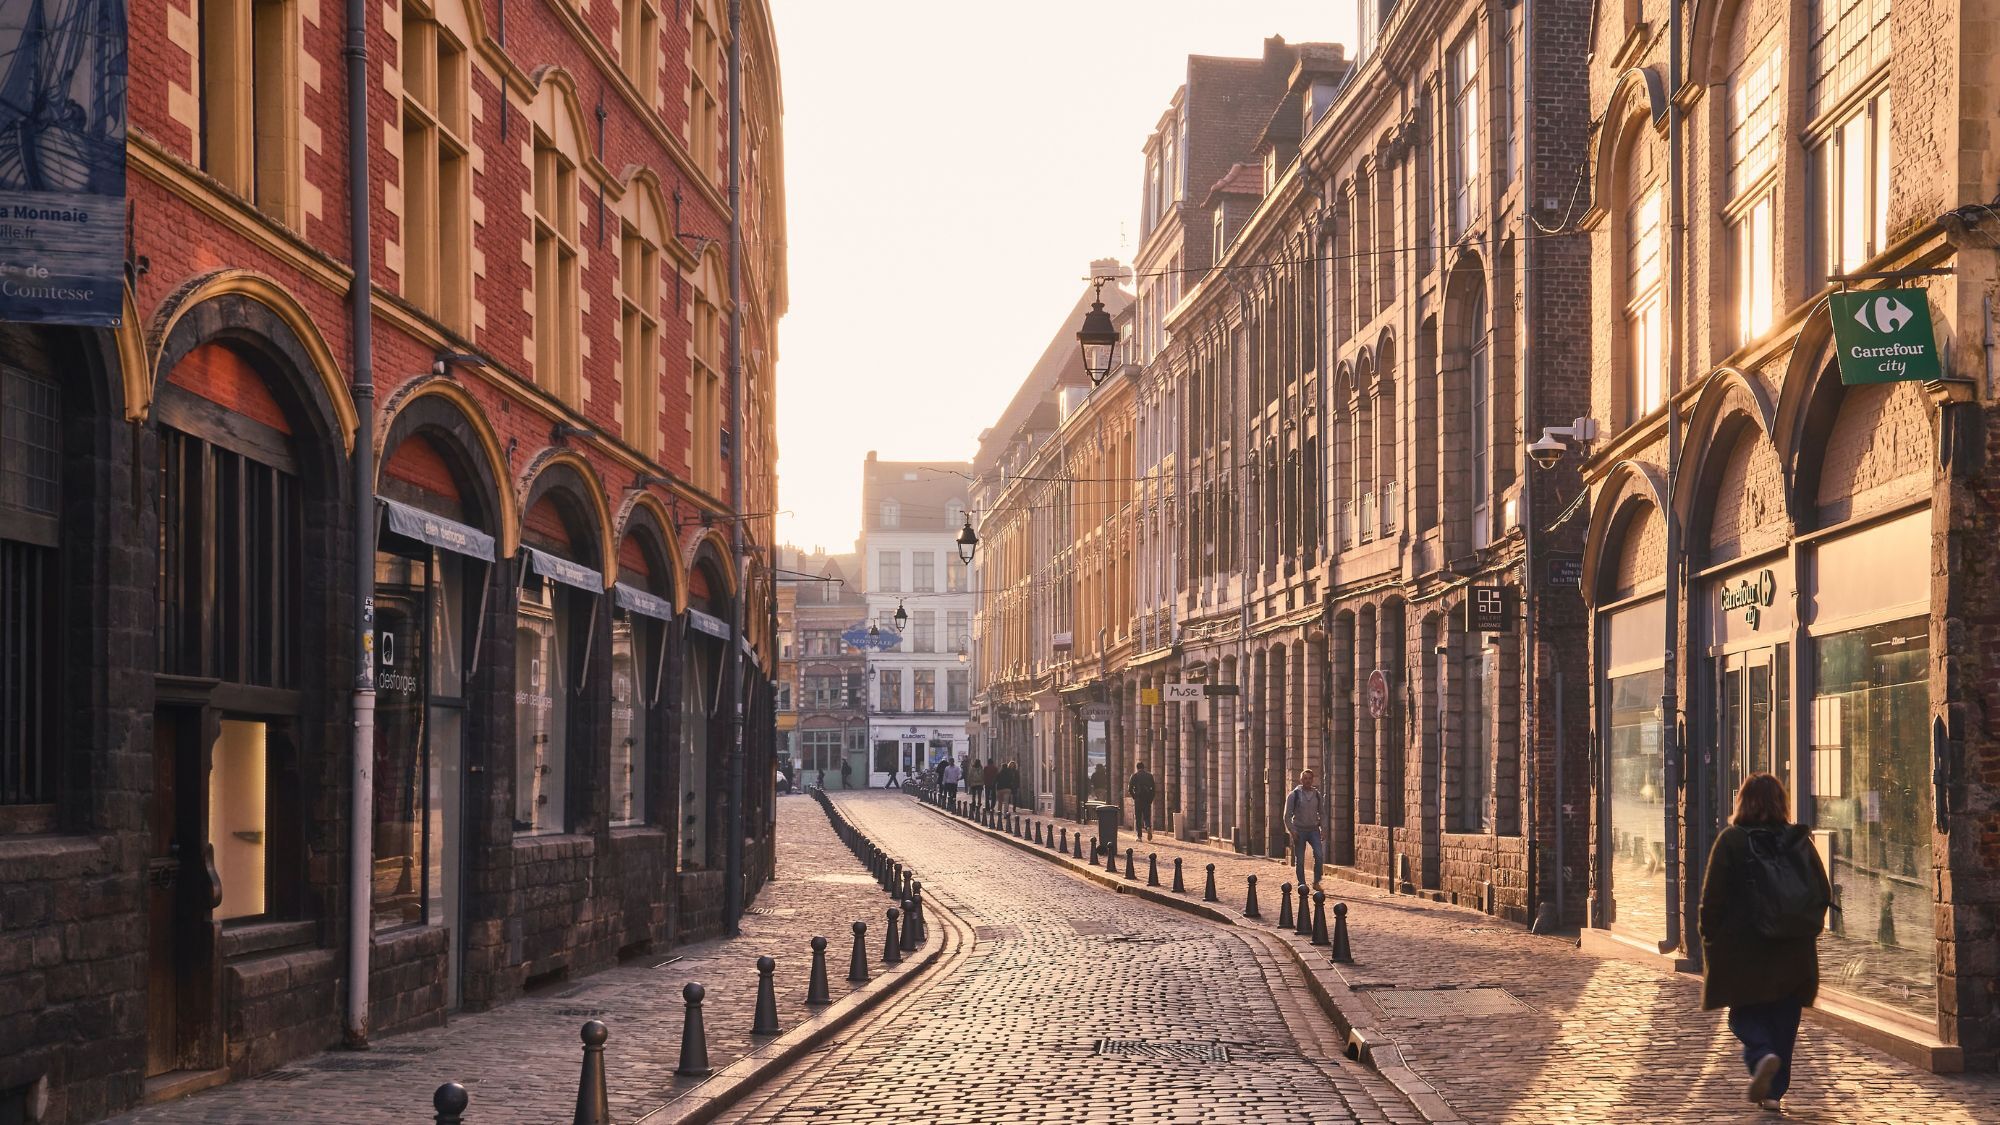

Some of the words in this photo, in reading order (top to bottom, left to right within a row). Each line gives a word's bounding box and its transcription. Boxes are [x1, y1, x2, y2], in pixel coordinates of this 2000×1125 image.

[14, 205, 89, 223] Monnaie
[26, 263, 49, 279] de
[2, 279, 95, 301] Comtesse
[1851, 342, 1924, 359] Carrefour
[1878, 360, 1906, 376] city
[1720, 580, 1759, 611] Carrefour
[379, 670, 417, 696] desforges
[1170, 685, 1199, 697] Muse
